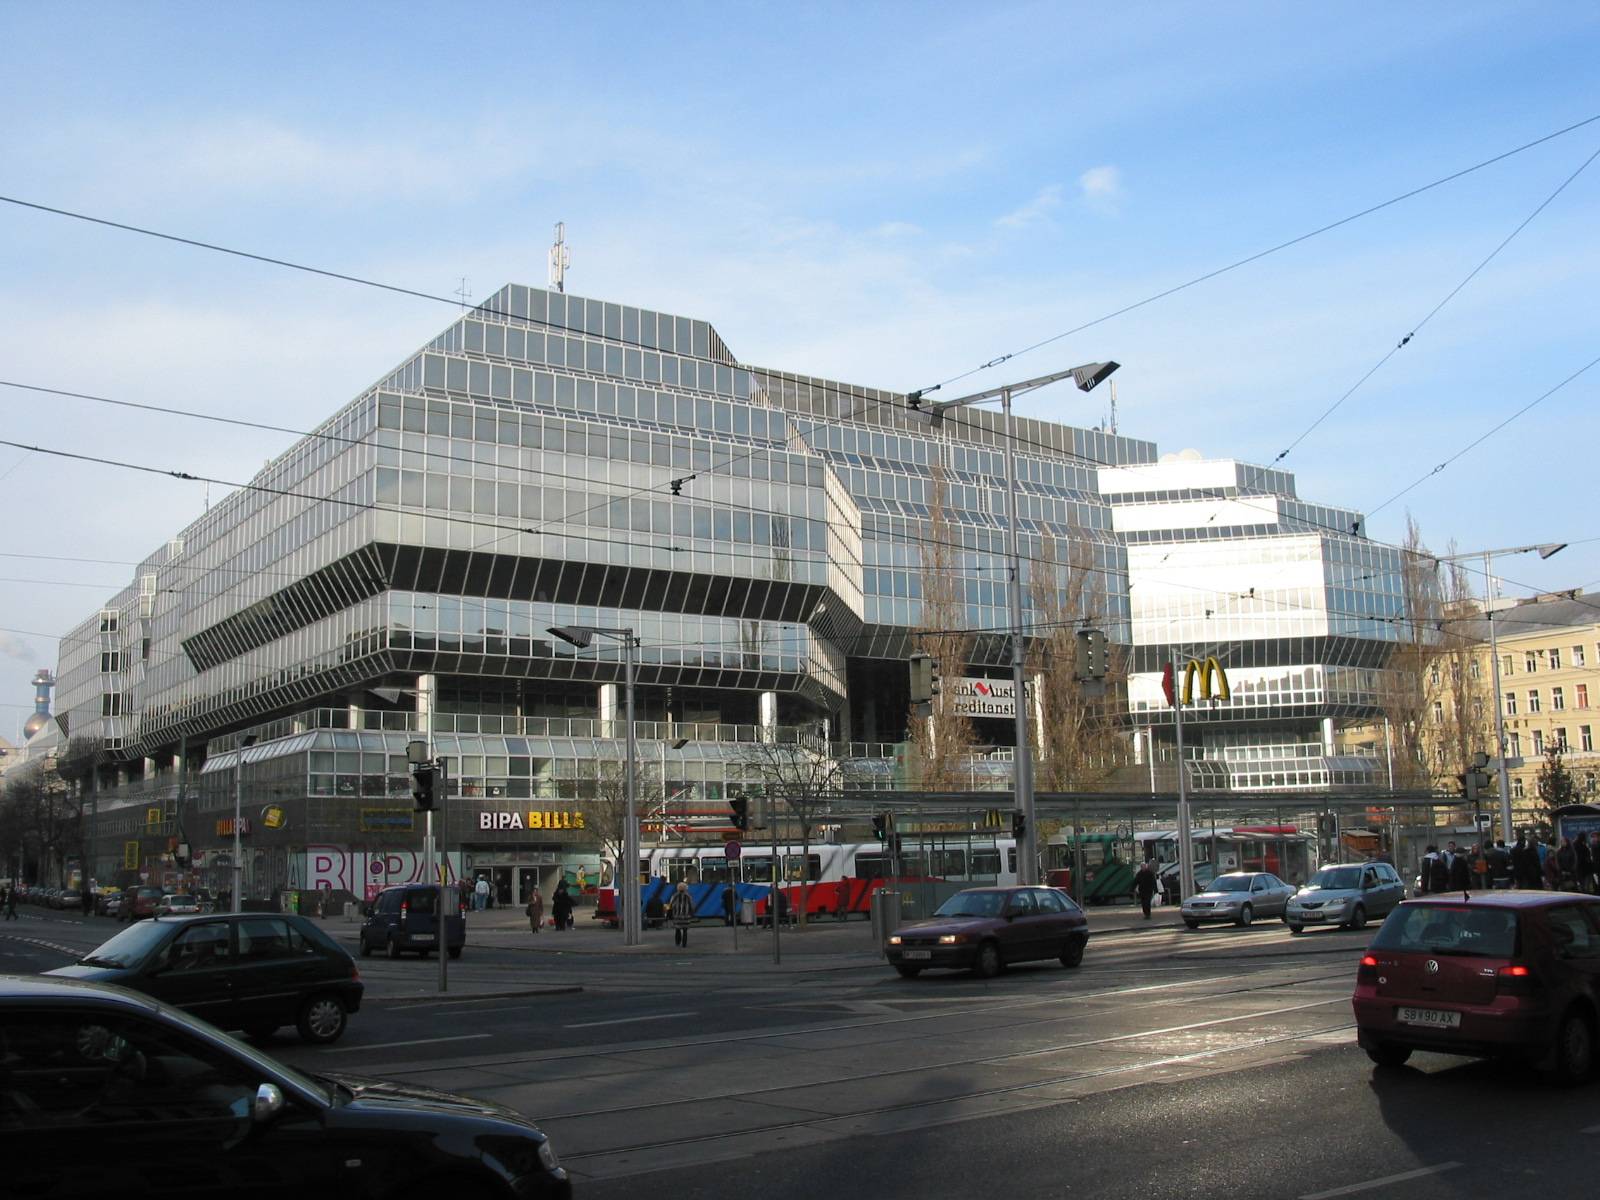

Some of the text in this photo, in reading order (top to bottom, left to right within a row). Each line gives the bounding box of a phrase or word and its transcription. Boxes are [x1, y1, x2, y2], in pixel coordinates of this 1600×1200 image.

[951, 683, 1031, 699] ank Austa
[480, 811, 524, 830] BIPA
